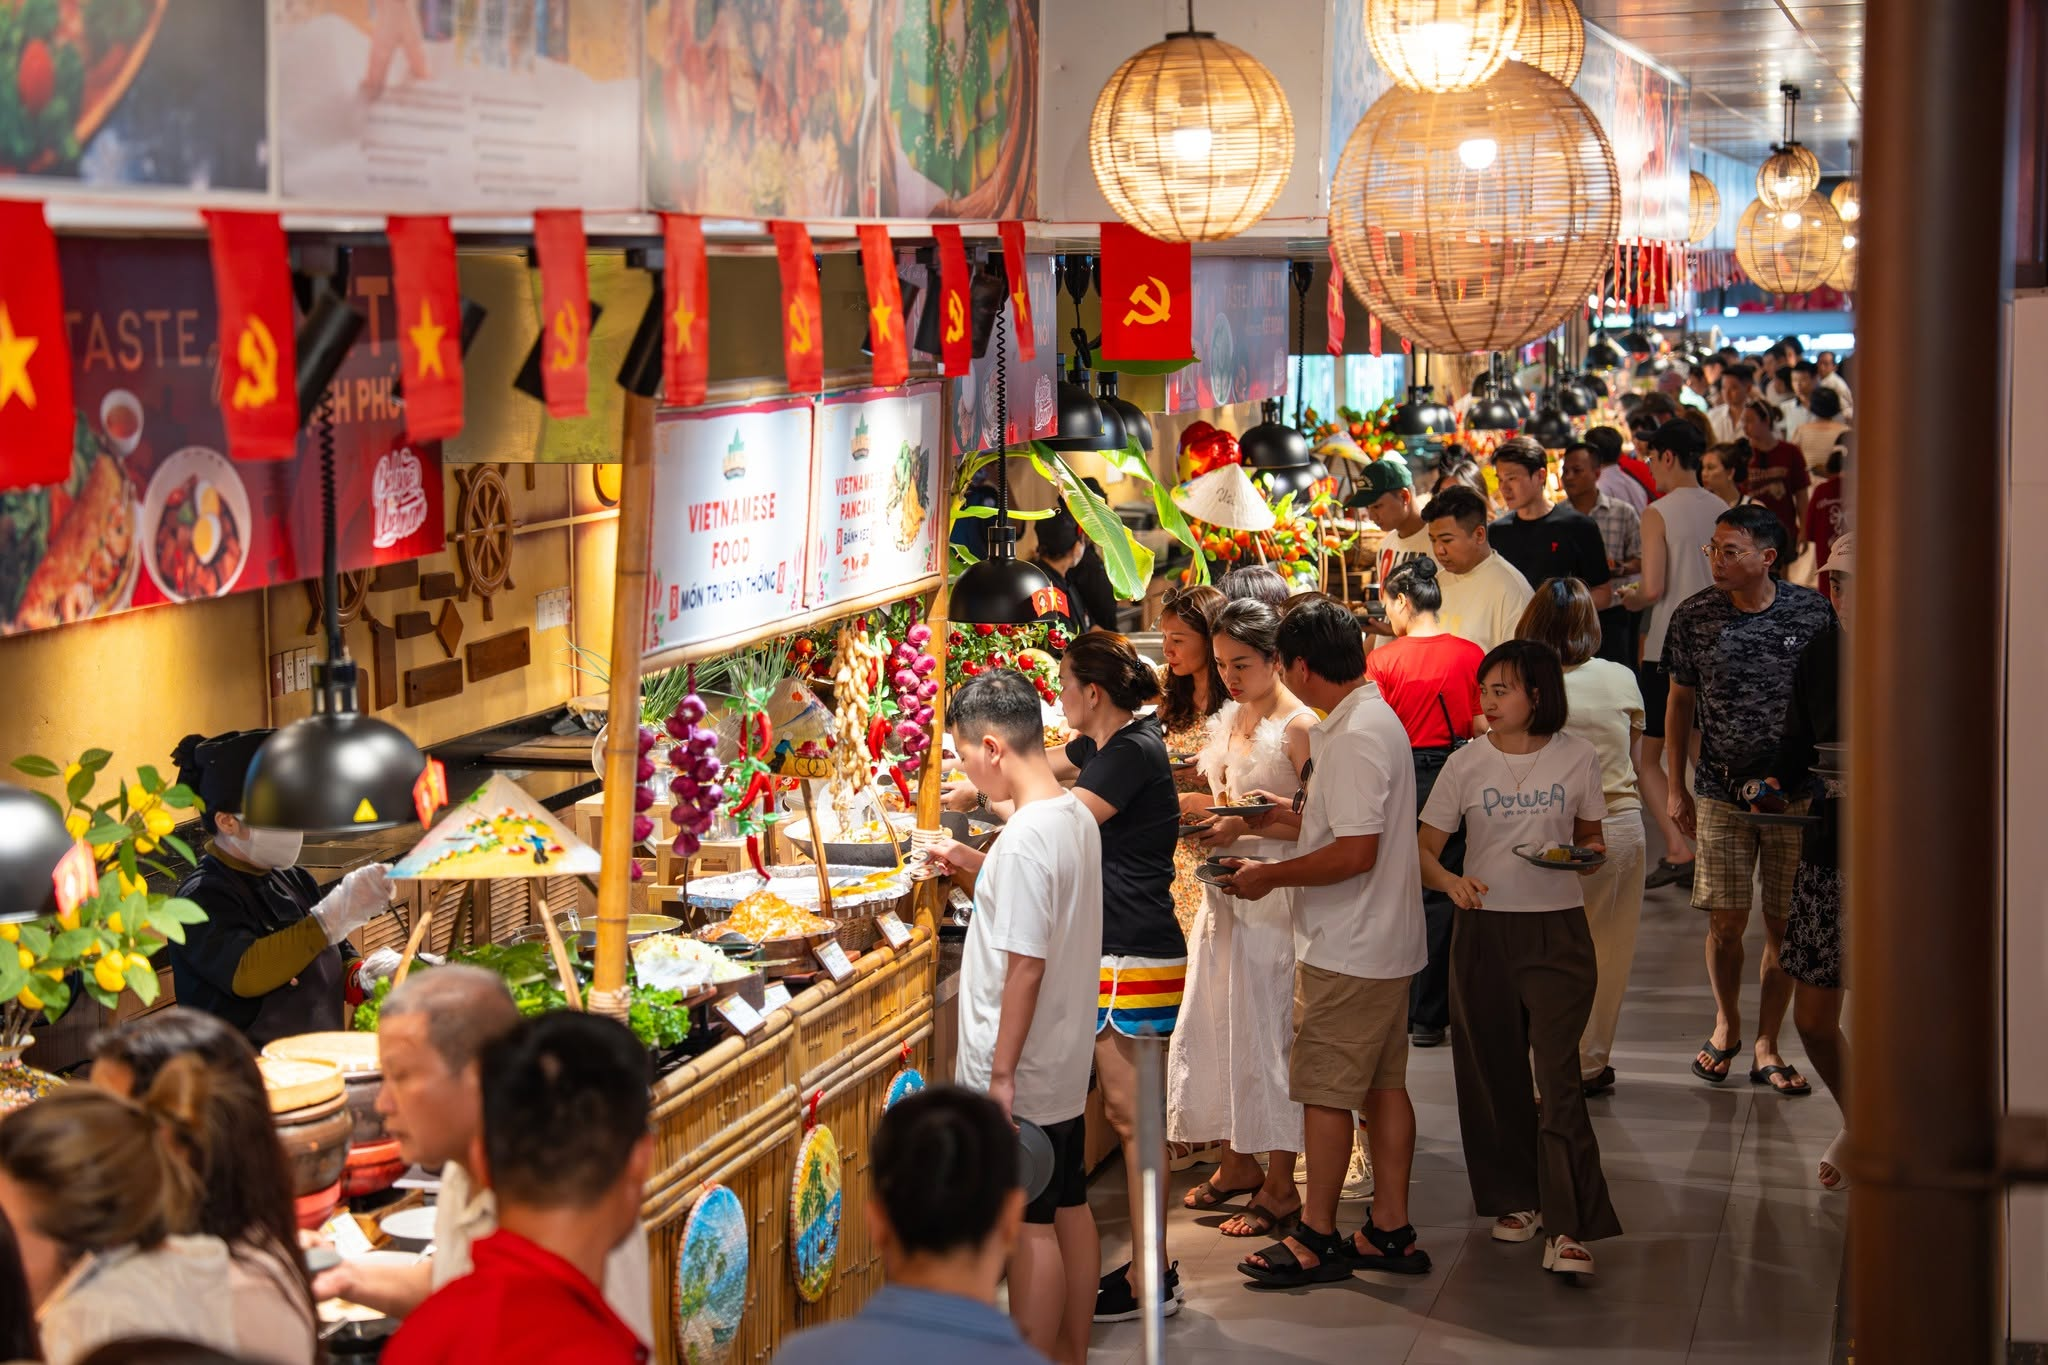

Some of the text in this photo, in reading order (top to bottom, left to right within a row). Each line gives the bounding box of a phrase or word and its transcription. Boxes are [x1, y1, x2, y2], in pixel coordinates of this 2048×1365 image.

[688, 492, 776, 534] VIETNAMESE
[712, 537, 750, 569] FOOD
[680, 582, 703, 612] MÓN
